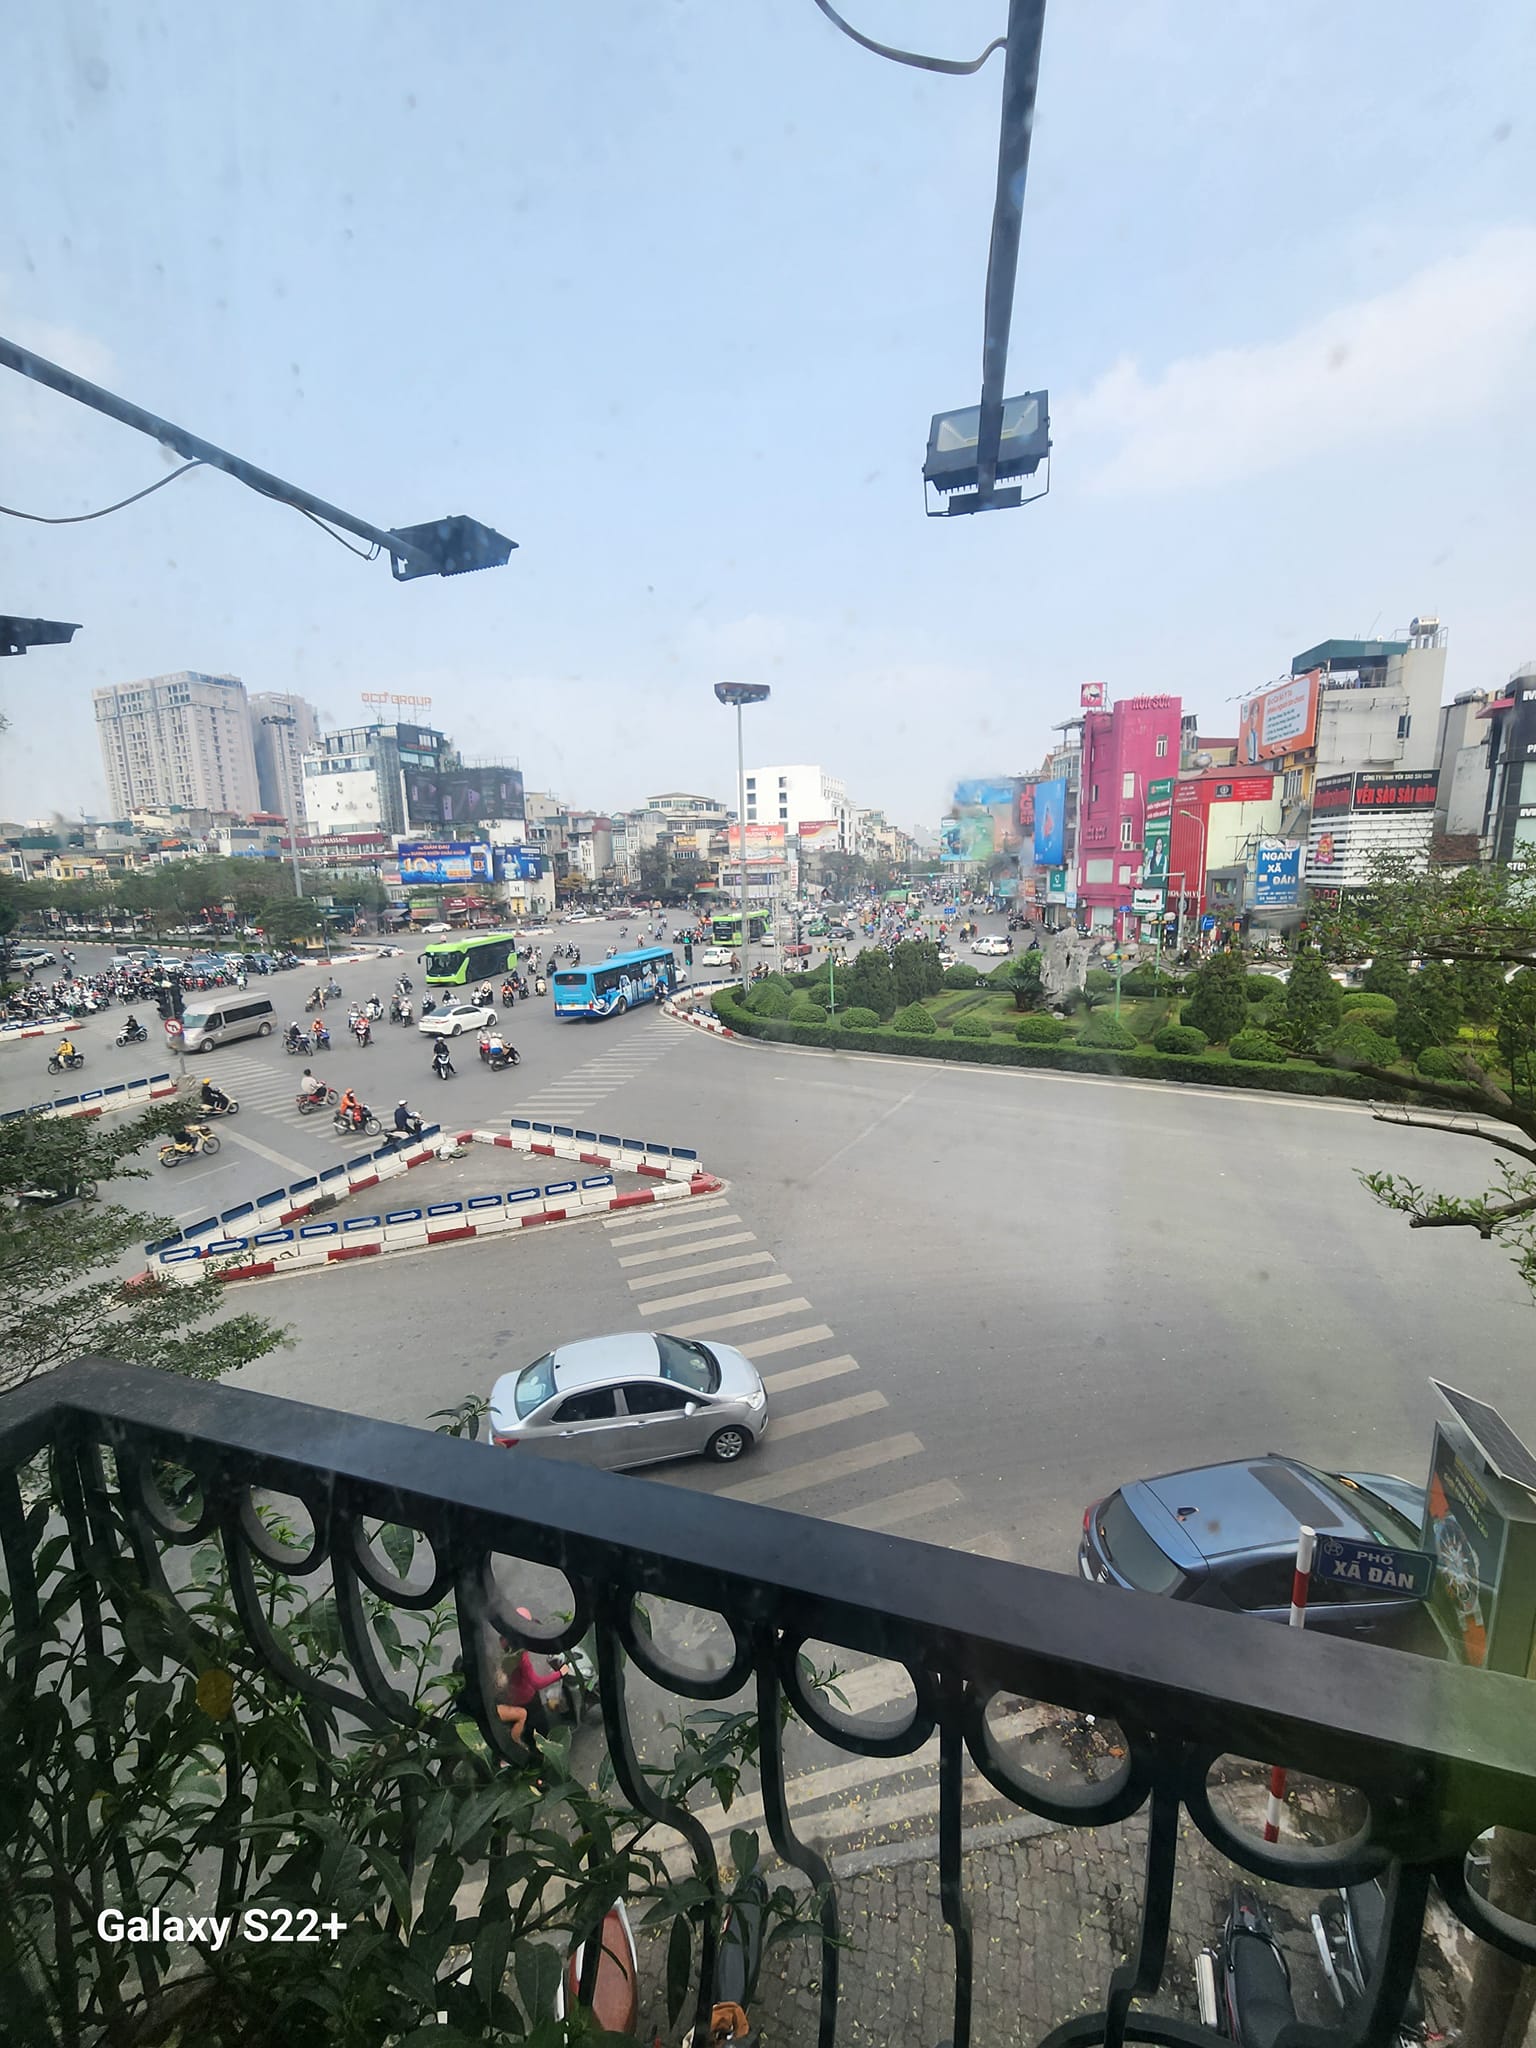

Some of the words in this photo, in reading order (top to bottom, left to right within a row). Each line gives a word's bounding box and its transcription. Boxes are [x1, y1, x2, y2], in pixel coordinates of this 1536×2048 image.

[1356, 783, 1376, 804] YẾN
[1376, 784, 1396, 803] SÀO
[1262, 852, 1293, 861] NGAN
[1267, 862, 1282, 873] XÃ
[1356, 1551, 1394, 1565] PHỐ
[1332, 1560, 1361, 1580] XÃ
[1368, 1567, 1414, 1589] ĐÀN
